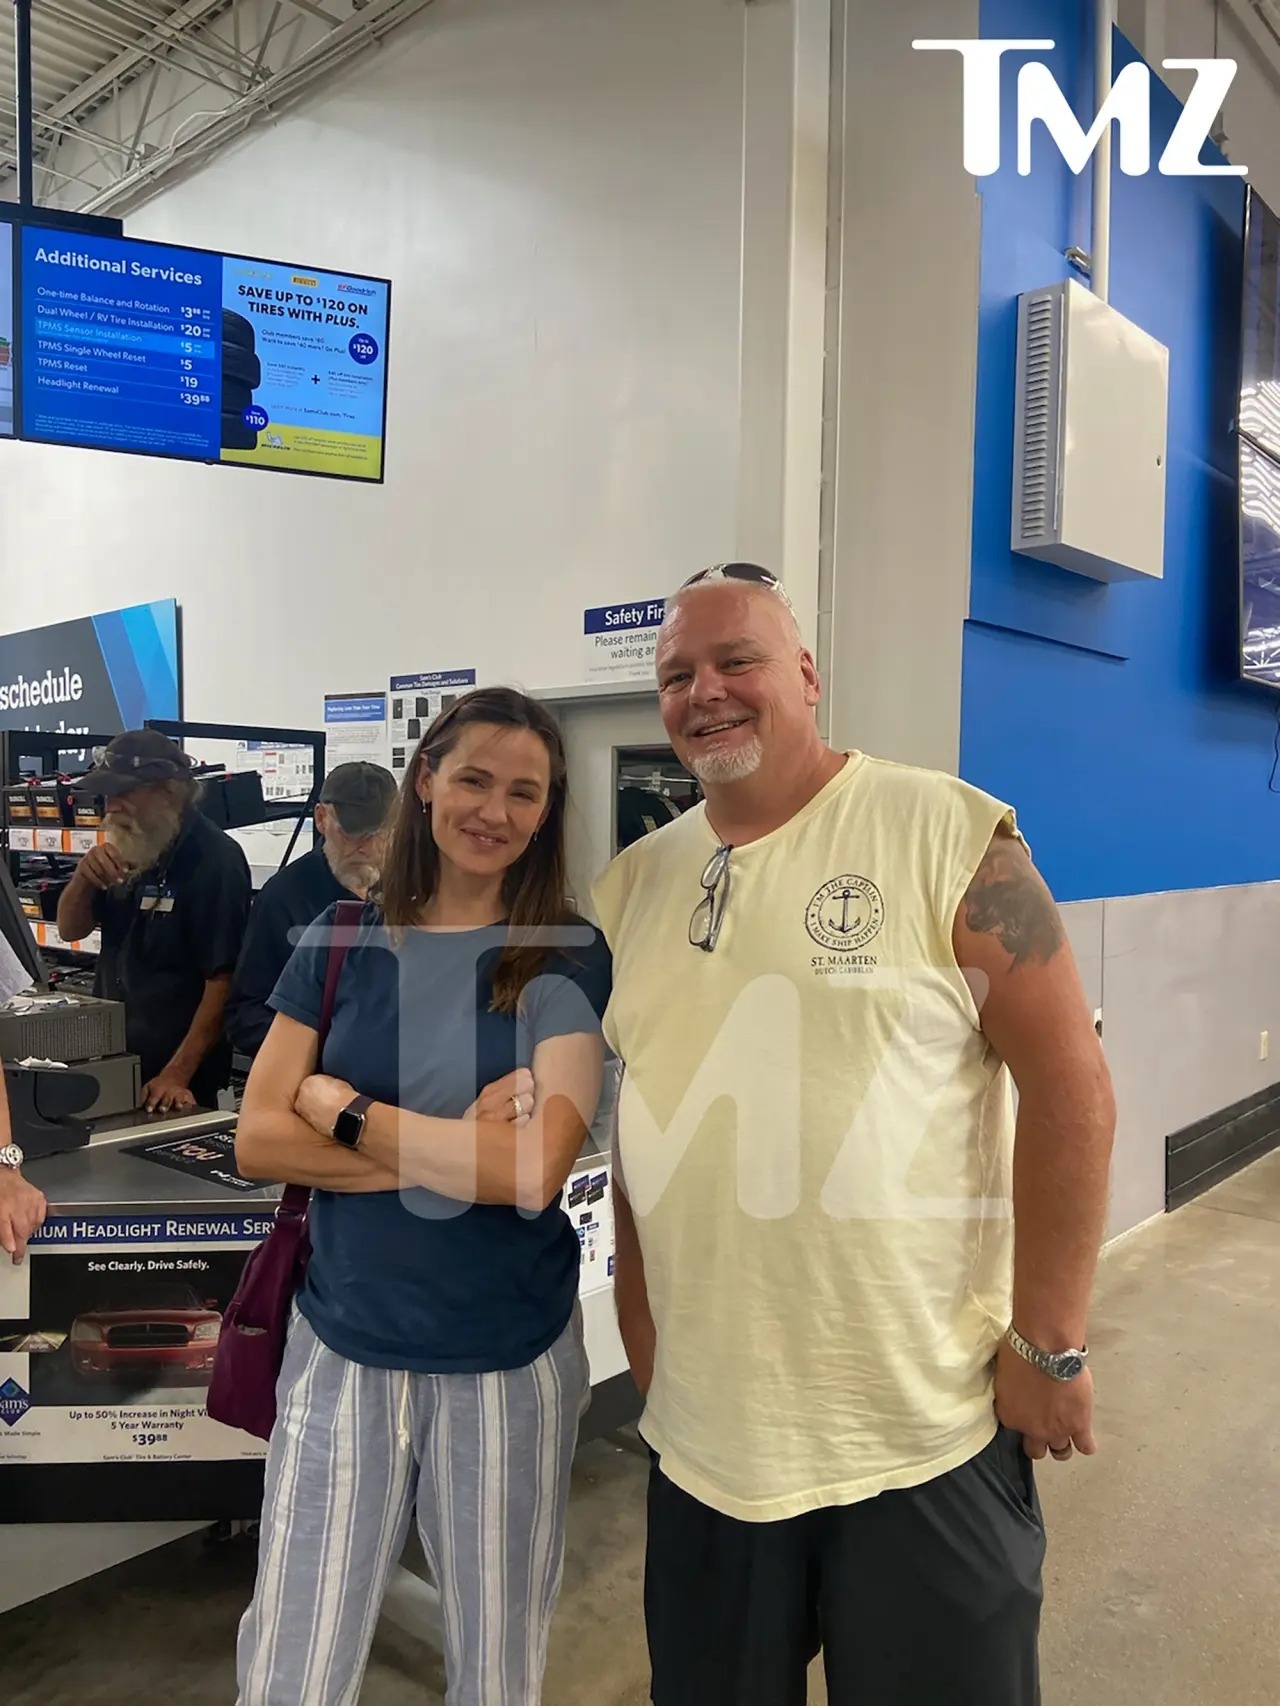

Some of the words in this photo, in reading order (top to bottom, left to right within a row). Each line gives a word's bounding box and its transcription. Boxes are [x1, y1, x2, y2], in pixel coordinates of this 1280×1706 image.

[35, 248, 126, 274] Additional
[131, 262, 202, 285] Services
[37, 287, 78, 300] One-time
[80, 292, 114, 306] Balance
[116, 299, 133, 308] and
[134, 300, 170, 314] Rotation
[238, 284, 272, 300] SAVE
[275, 292, 293, 302] UP
[295, 294, 314, 306] TO
[316, 298, 344, 312] $120
[348, 302, 368, 315] ON
[38, 304, 58, 316] Dual
[59, 308, 88, 320] Wheel
[90, 312, 95, 322] /
[97, 312, 108, 322] RV
[110, 314, 127, 326] Tire
[128, 318, 174, 332] Installation
[248, 301, 284, 317] TIRES
[287, 308, 322, 322] WITH
[325, 314, 360, 329] PLUS.
[38, 320, 62, 332] TPMS
[64, 324, 94, 336] Sensor
[96, 328, 142, 342] Installation
[181, 324, 200, 336] $20
[38, 340, 62, 352] TPMS
[64, 343, 92, 356] Single
[94, 347, 121, 360] Wheel
[122, 351, 146, 363] Reset
[181, 341, 192, 353] $5
[353, 343, 373, 355] $120
[38, 358, 62, 369] TPMS
[64, 360, 88, 372] Reset
[181, 359, 193, 371] $5
[37, 376, 81, 390] Headlight
[83, 382, 119, 394] Renewal
[181, 376, 198, 388] $19
[246, 414, 265, 426] $110
[605, 608, 644, 626] Safety
[647, 604, 665, 620] Fir
[595, 635, 623, 647] Please
[625, 630, 656, 644] remain
[611, 646, 643, 659] waiting
[0, 666, 82, 710] schedule
[826, 880, 844, 893] THE
[846, 878, 878, 902] CAPTAIN
[811, 926, 829, 944] MAKE
[854, 919, 878, 944] HAPPEN
[811, 956, 825, 967] ST.
[828, 956, 877, 966] MAARTEN
[34, 1223, 68, 1240] IUM
[73, 1221, 161, 1238] HEADLIGHT
[166, 1220, 238, 1236] RENEWAL
[88, 1261, 106, 1272] See
[108, 1260, 146, 1272] Clearly.
[148, 1260, 174, 1270] Drive
[176, 1260, 210, 1271] Safely.
[0, 1398, 29, 1410] am's
[69, 1411, 82, 1420] Up
[96, 1411, 117, 1419] 50%
[119, 1410, 157, 1418] Increase
[159, 1410, 168, 1418] in
[170, 1409, 195, 1419] Night
[197, 1409, 209, 1417] Vi
[119, 1421, 139, 1429] Year
[141, 1421, 184, 1430] Warranty
